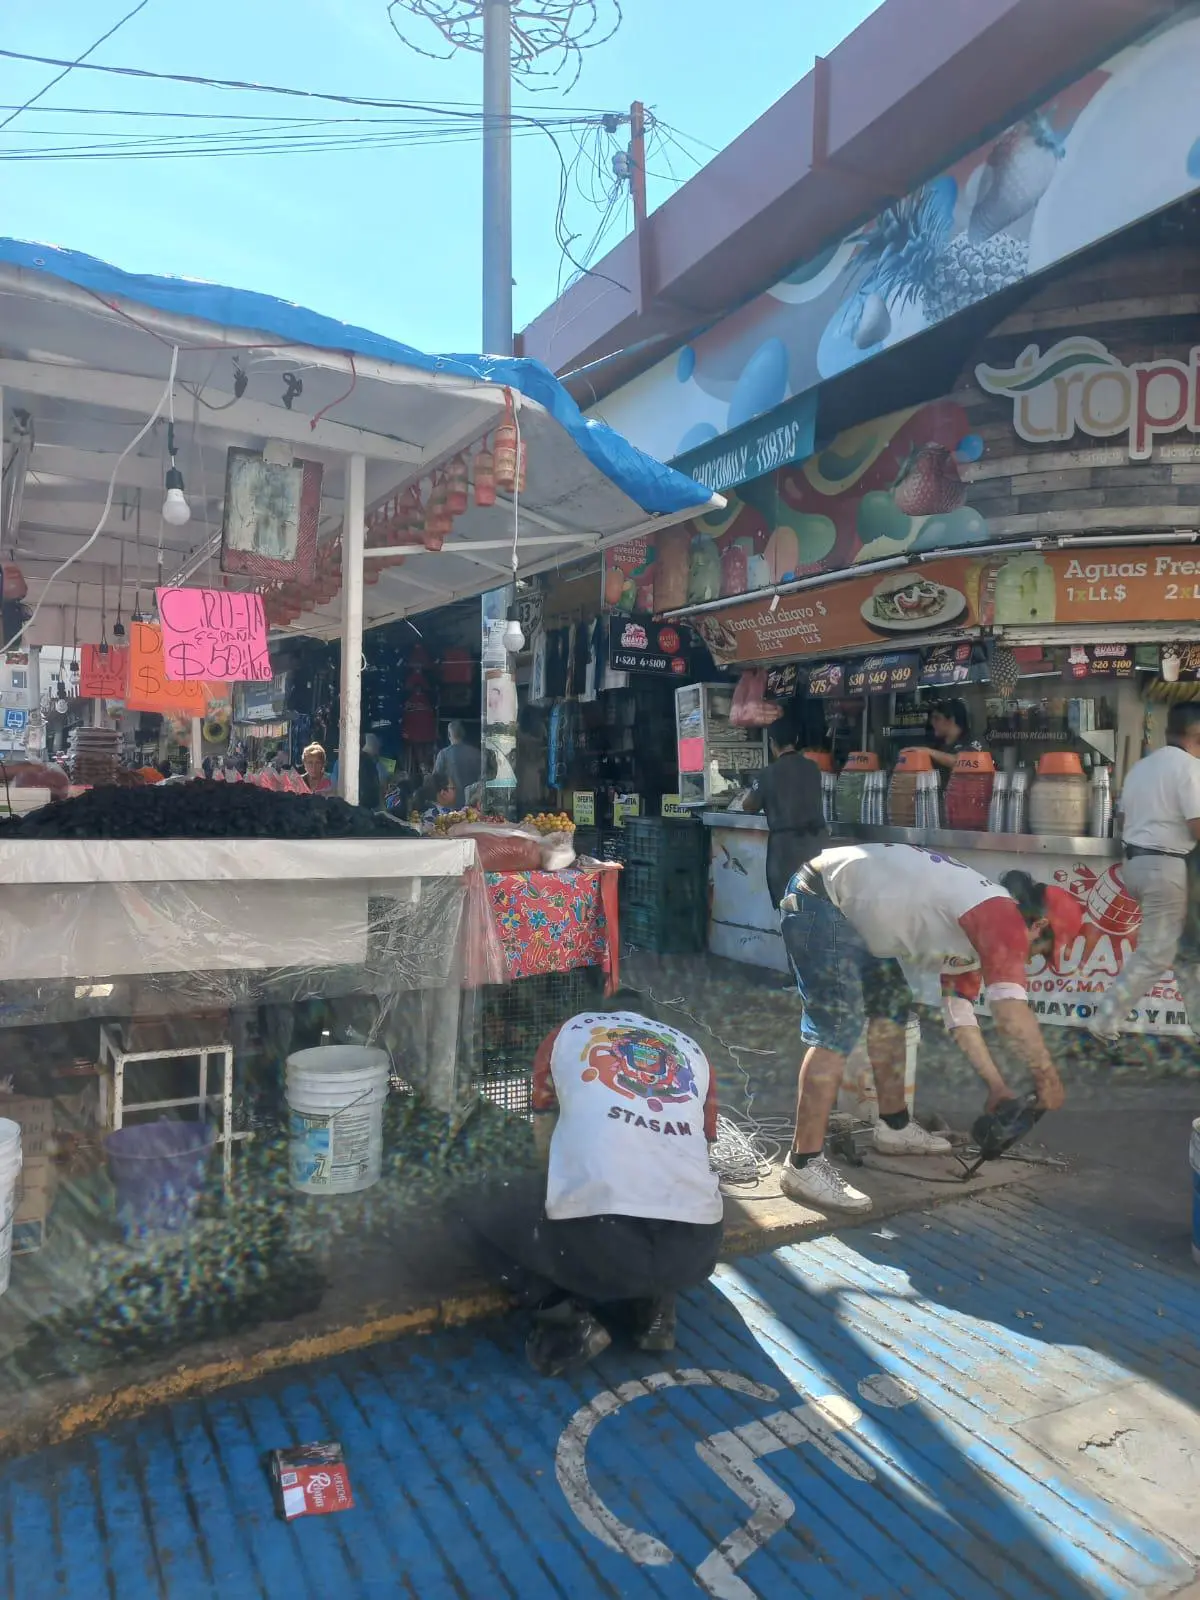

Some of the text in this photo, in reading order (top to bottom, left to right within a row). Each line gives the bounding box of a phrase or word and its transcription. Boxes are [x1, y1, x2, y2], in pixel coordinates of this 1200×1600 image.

[756, 420, 799, 472] TORTAS
[1064, 560, 1148, 583] Aguas
[727, 600, 827, 632] Torta del chavo $
[755, 621, 819, 641] Escamocha
[809, 679, 827, 693] $75
[868, 670, 888, 684] $49
[1025, 978, 1073, 994] 100%
[571, 1016, 634, 1031] TODOS
[607, 1106, 692, 1136] STASAM
